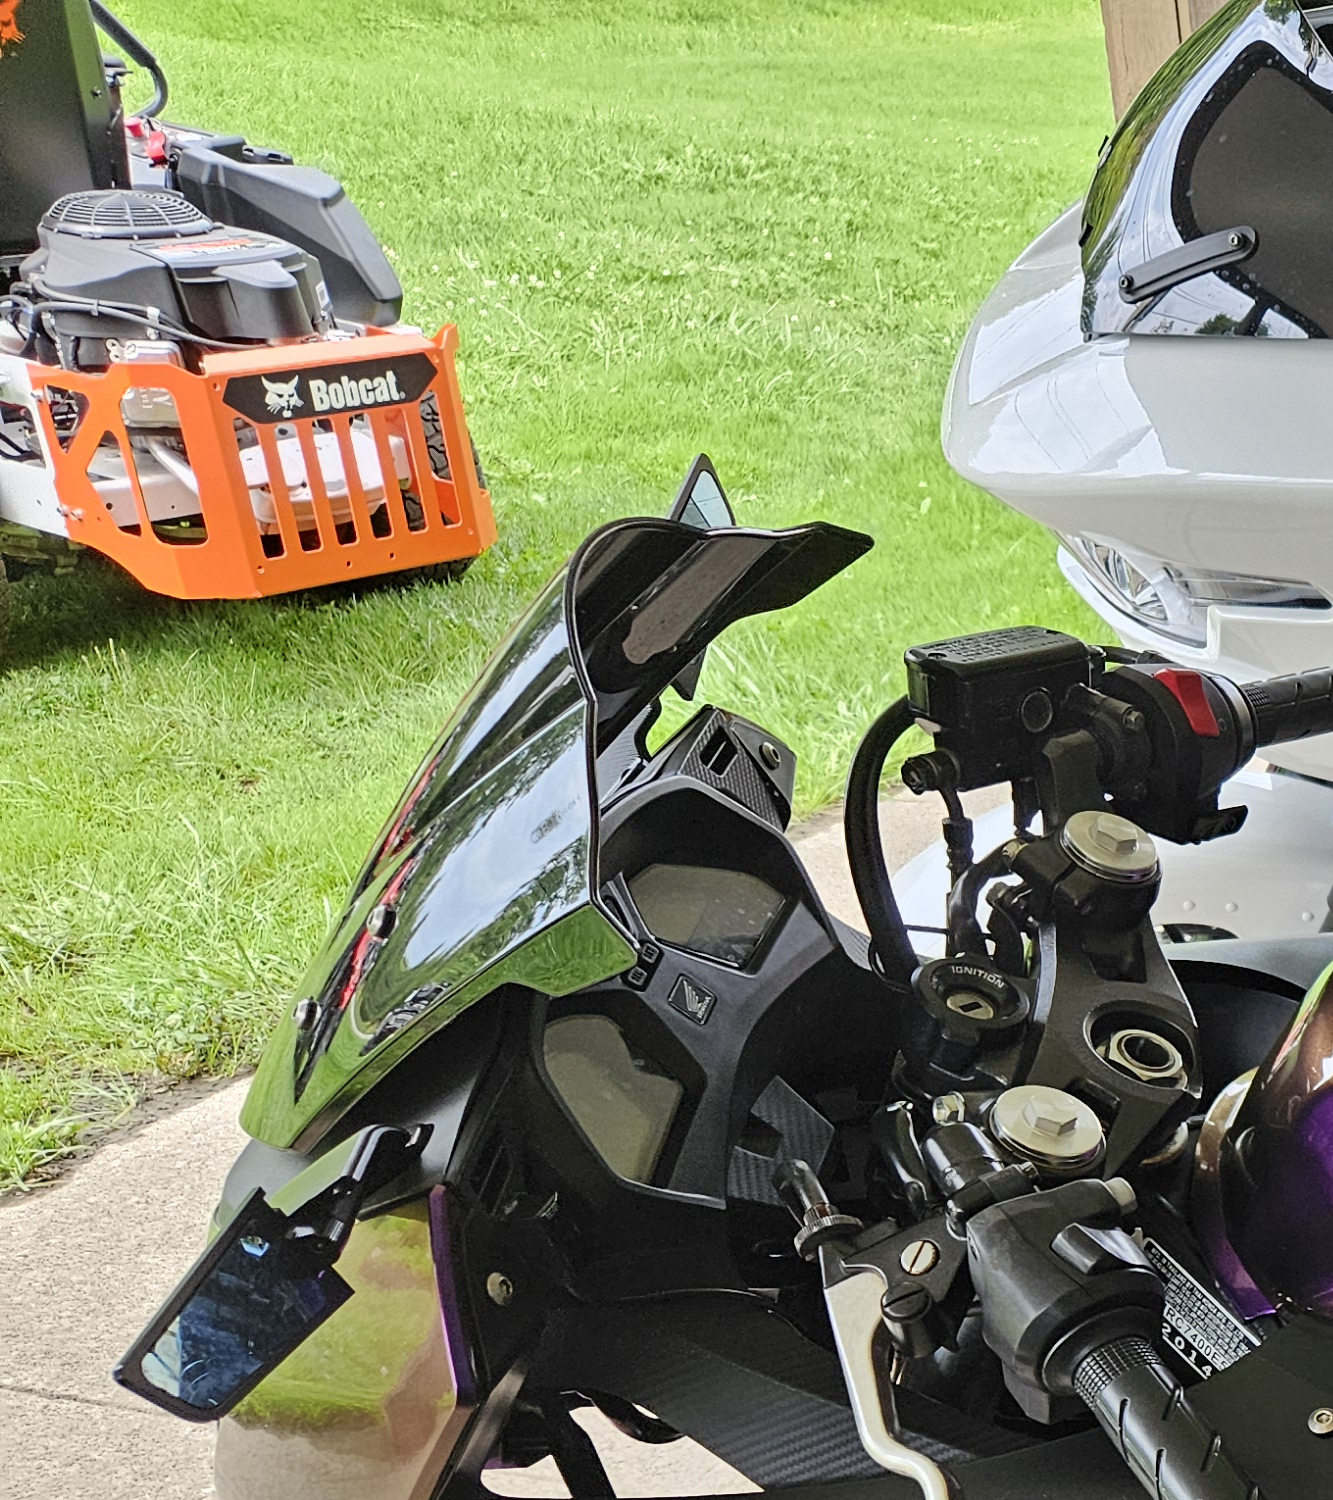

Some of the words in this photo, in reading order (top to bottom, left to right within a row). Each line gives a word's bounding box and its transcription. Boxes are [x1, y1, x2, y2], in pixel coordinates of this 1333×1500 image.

[309, 370, 400, 411] Bobcat
[951, 965, 1005, 988] IGNITION
[1162, 1322, 1213, 1377] 2014
